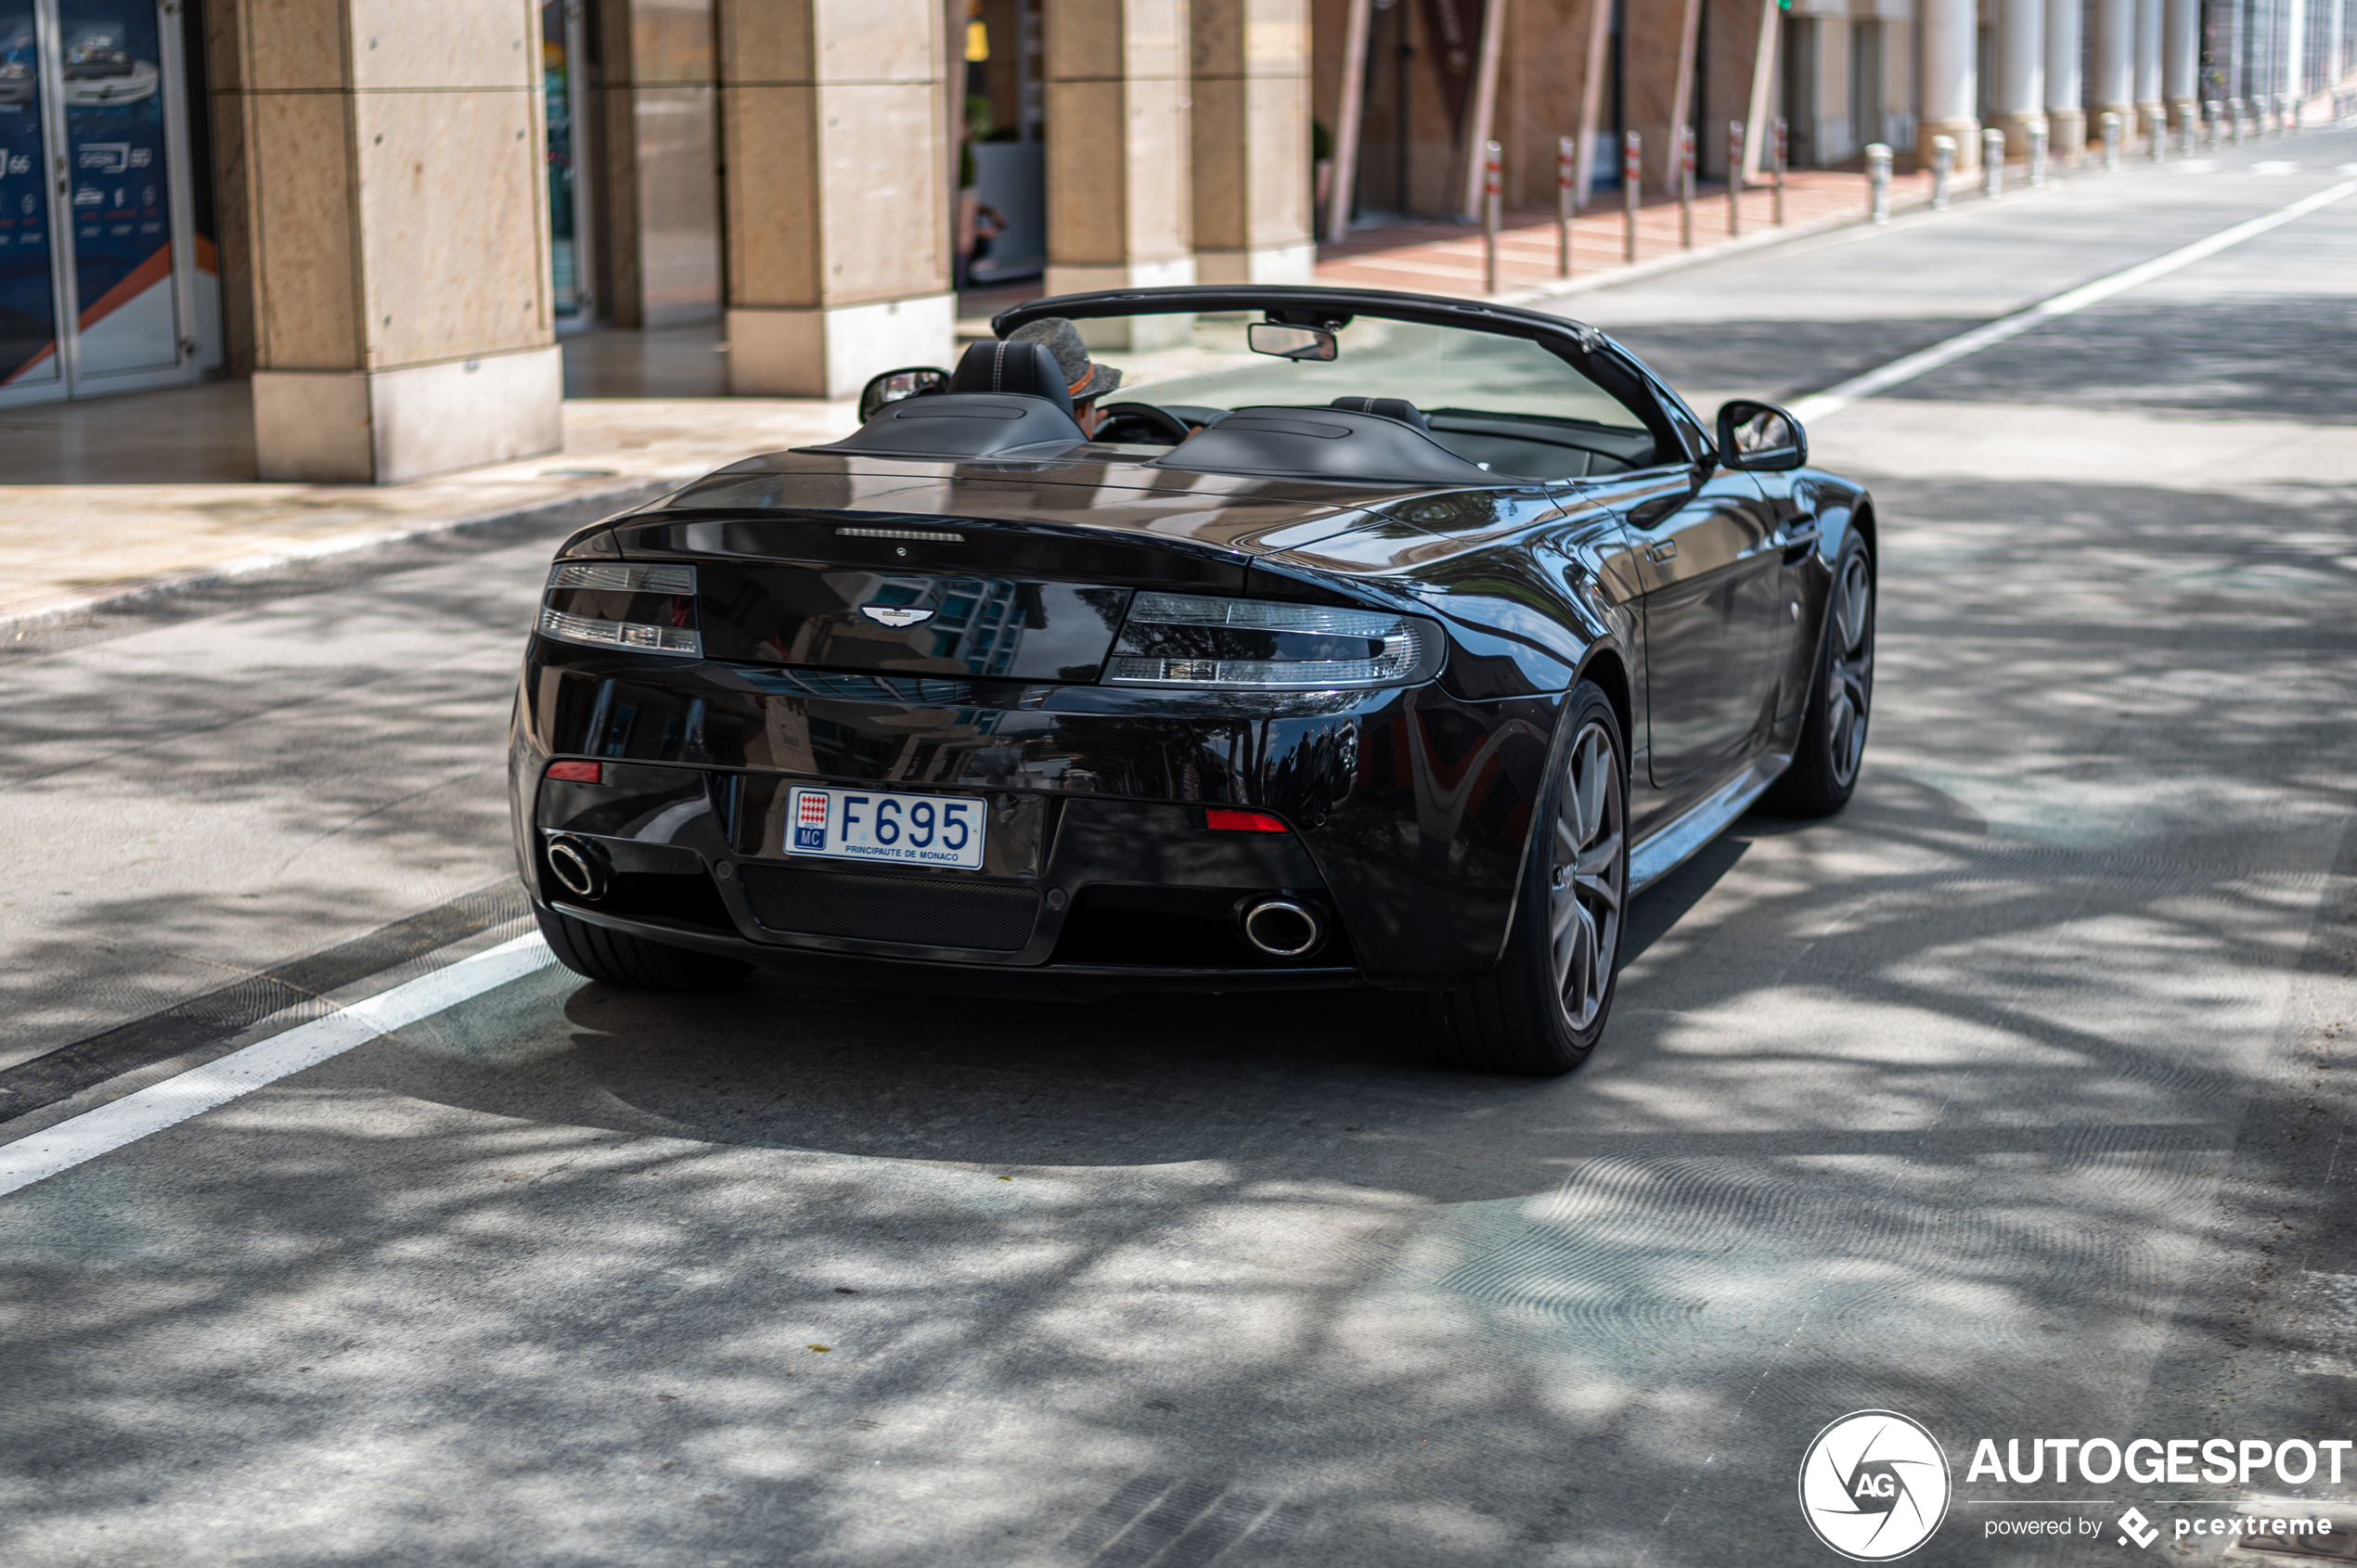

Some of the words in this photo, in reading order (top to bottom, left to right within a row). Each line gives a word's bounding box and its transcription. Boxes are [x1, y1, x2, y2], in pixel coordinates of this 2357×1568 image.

[841, 795, 969, 851] F695
[801, 830, 820, 845] MC
[844, 844, 902, 857] PRINCIPAUTE
[904, 849, 917, 858] DE
[919, 851, 960, 862] MONACO
